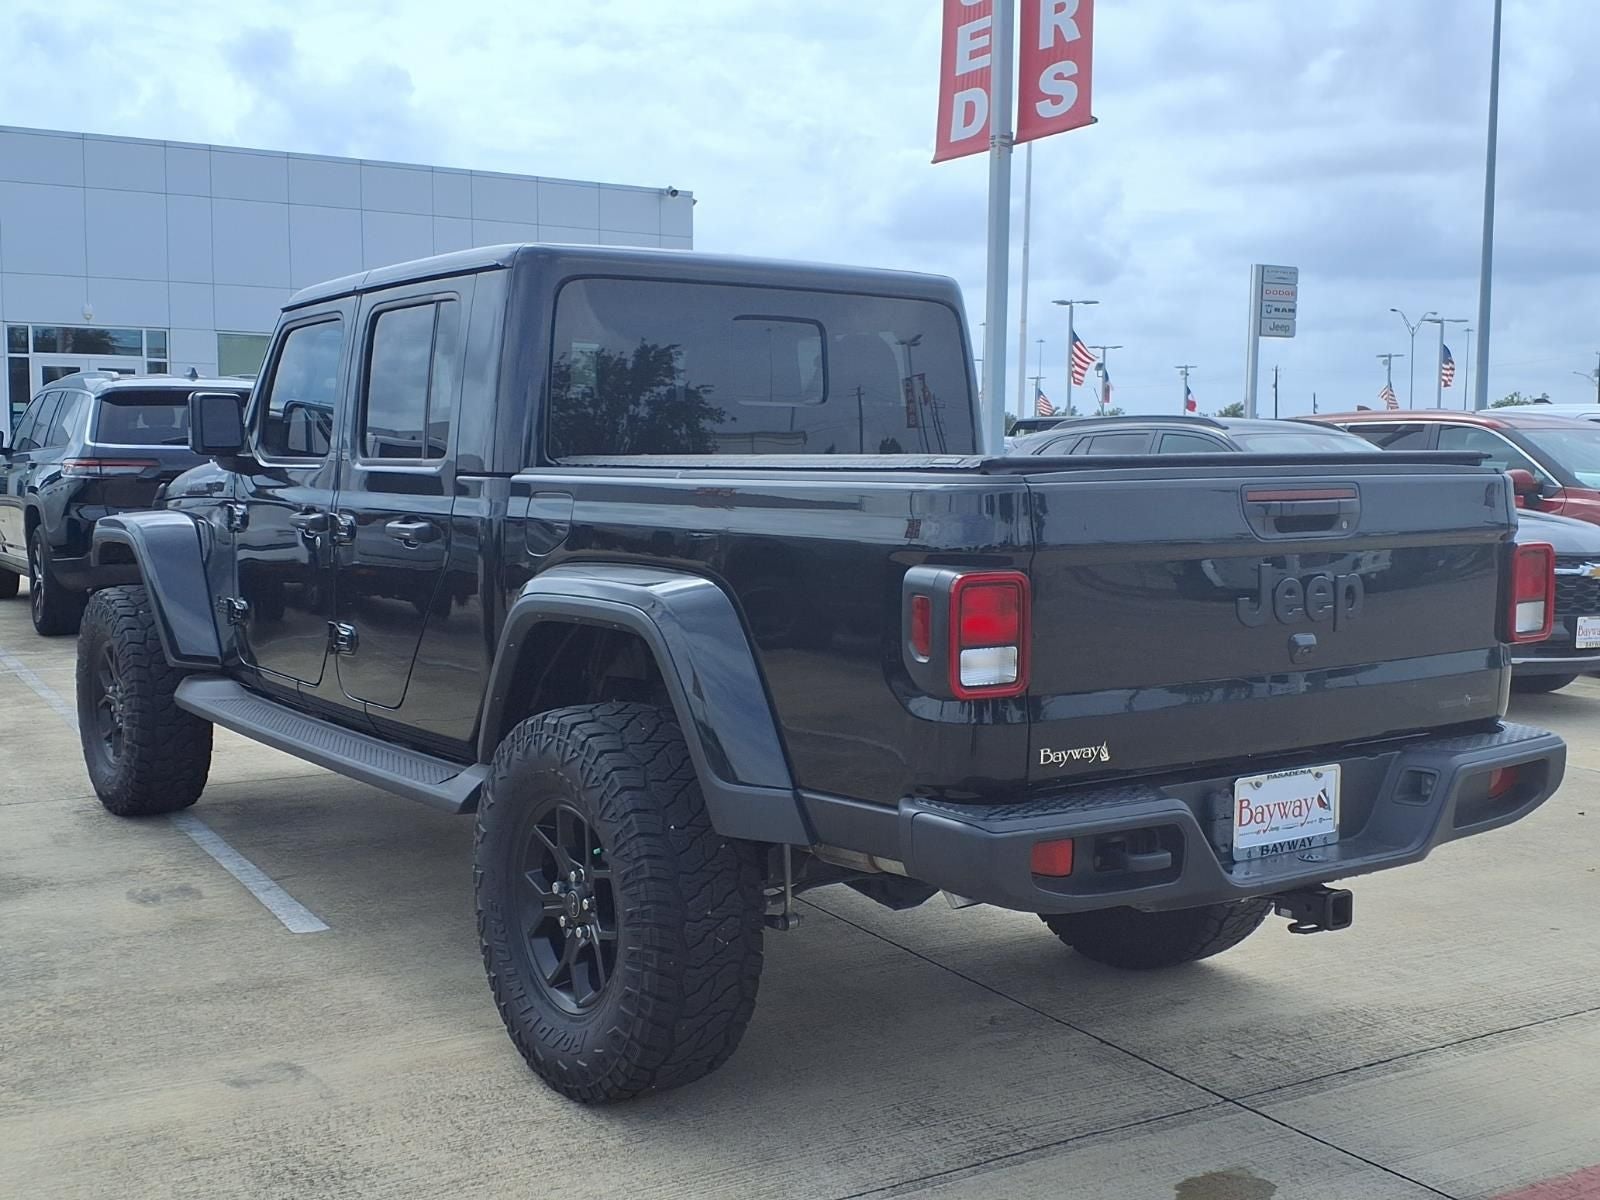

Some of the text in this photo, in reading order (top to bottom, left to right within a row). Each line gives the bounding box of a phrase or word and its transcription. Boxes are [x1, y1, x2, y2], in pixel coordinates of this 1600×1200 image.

[1265, 289, 1296, 297] DODGE
[1268, 321, 1290, 334] Jeep
[1235, 563, 1364, 633] Jeep
[1039, 745, 1101, 767] Bayway
[1266, 768, 1312, 780] PASADENA
[1238, 797, 1315, 834] Bayway
[1260, 836, 1314, 857] BAYWAY
